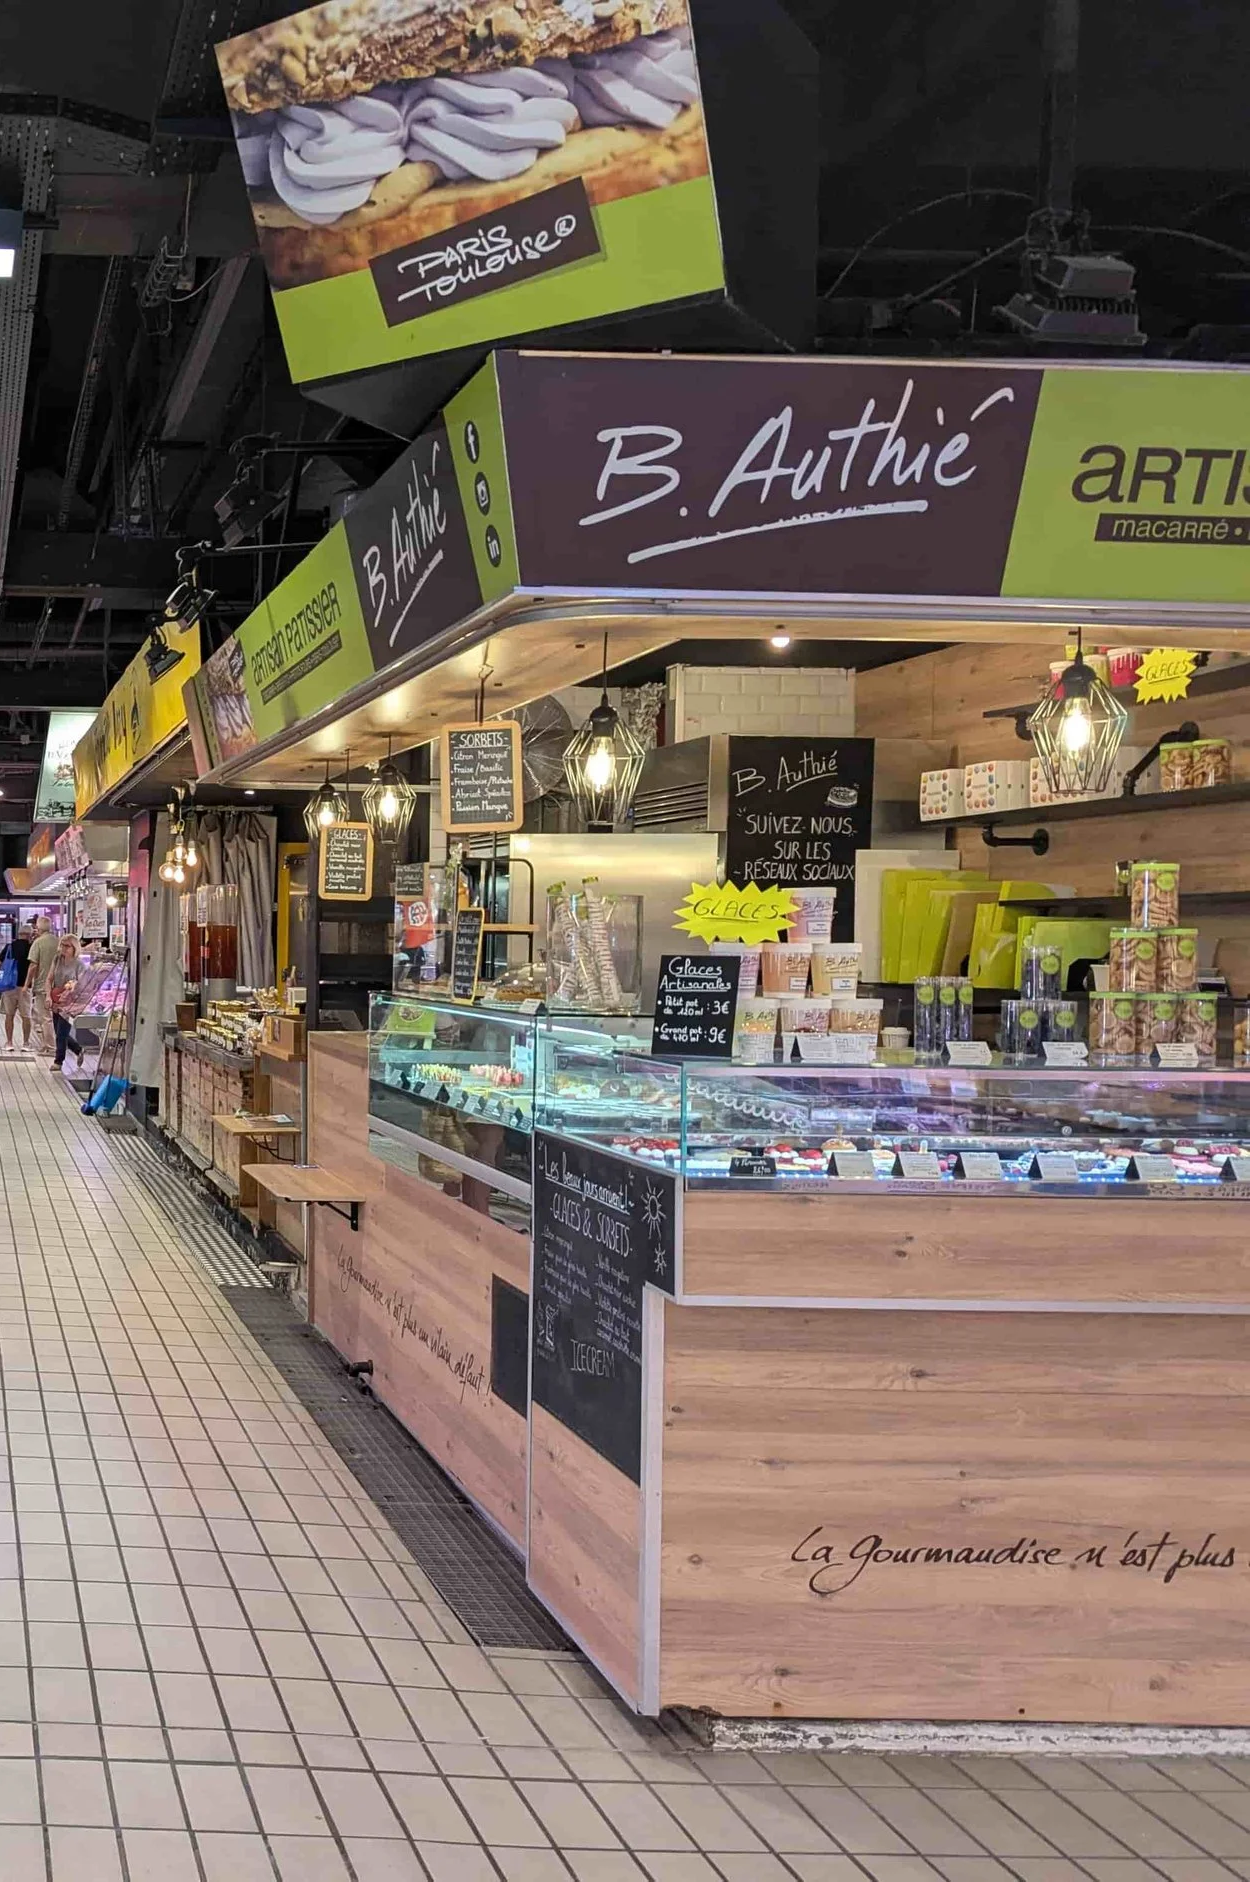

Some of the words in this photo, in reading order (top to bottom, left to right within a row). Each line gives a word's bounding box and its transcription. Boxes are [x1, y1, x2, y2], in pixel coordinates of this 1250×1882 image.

[398, 225, 514, 278] PARIS
[579, 426, 688, 526] B.
[708, 378, 1015, 518] Authié
[1071, 444, 1250, 506] aRTI
[392, 440, 446, 601] Authié
[1145, 660, 1189, 681] GLACES
[460, 732, 503, 747] SORBETS
[732, 768, 772, 796] B.
[777, 750, 838, 790] Authié
[334, 829, 358, 840] GLACES
[772, 840, 801, 860] SUR
[806, 842, 832, 860] LES
[744, 858, 798, 880] RÉSEAUX
[802, 862, 855, 880] SOCIAUX
[693, 898, 780, 920] GLACES
[668, 956, 722, 976] Glaces
[660, 975, 732, 990] Artisanales
[665, 995, 684, 1006] Petit
[686, 998, 698, 1010] pot
[712, 1000, 730, 1015] 3€
[660, 1022, 688, 1034] Grand
[690, 1026, 702, 1037] pot
[708, 1026, 726, 1044] 9€
[553, 1193, 581, 1232] GLACES
[596, 1212, 630, 1258] SORBETS
[790, 1526, 832, 1563] La
[809, 1534, 1067, 1595] gourmandise
[1164, 1532, 1236, 1583] plus
